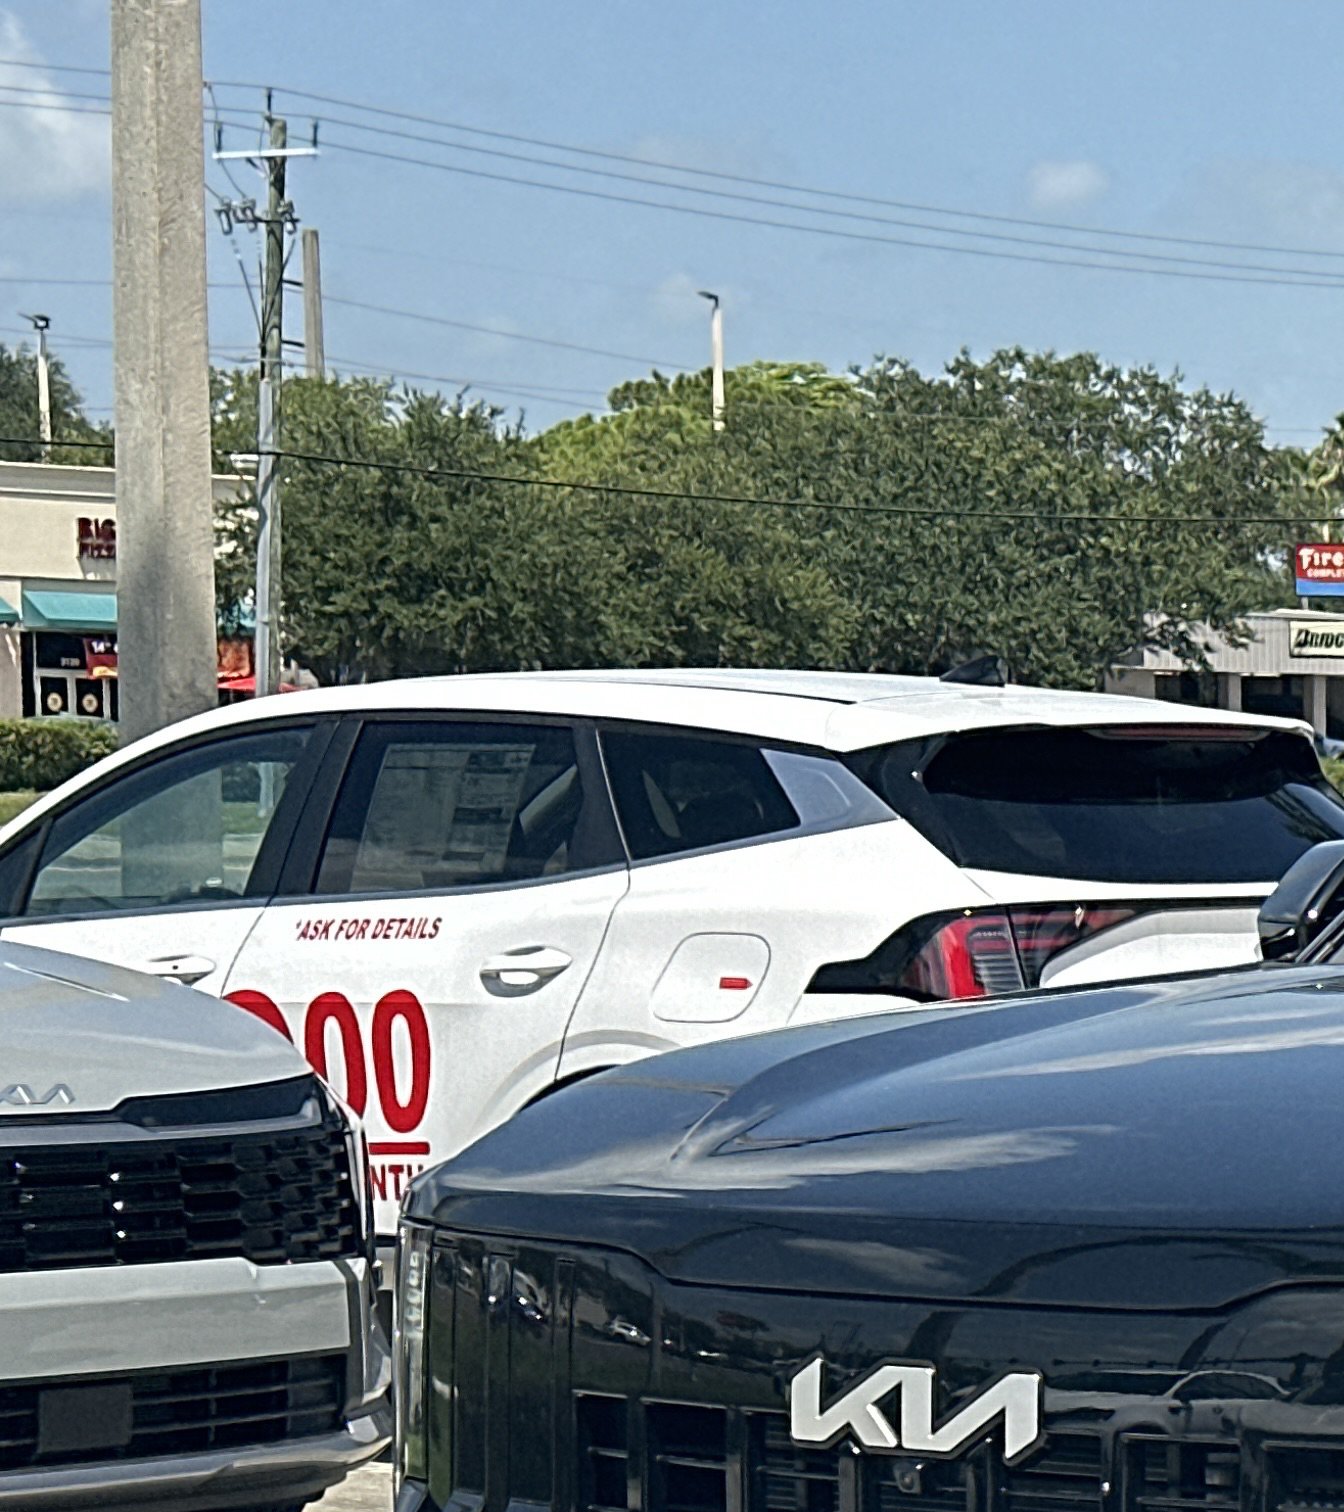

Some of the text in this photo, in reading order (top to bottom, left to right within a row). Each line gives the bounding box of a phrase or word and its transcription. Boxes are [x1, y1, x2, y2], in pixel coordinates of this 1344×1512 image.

[334, 918, 371, 940] FOR
[371, 917, 443, 939] DETAILS
[223, 989, 431, 1133] 00
[790, 1355, 1041, 1461] KIA
